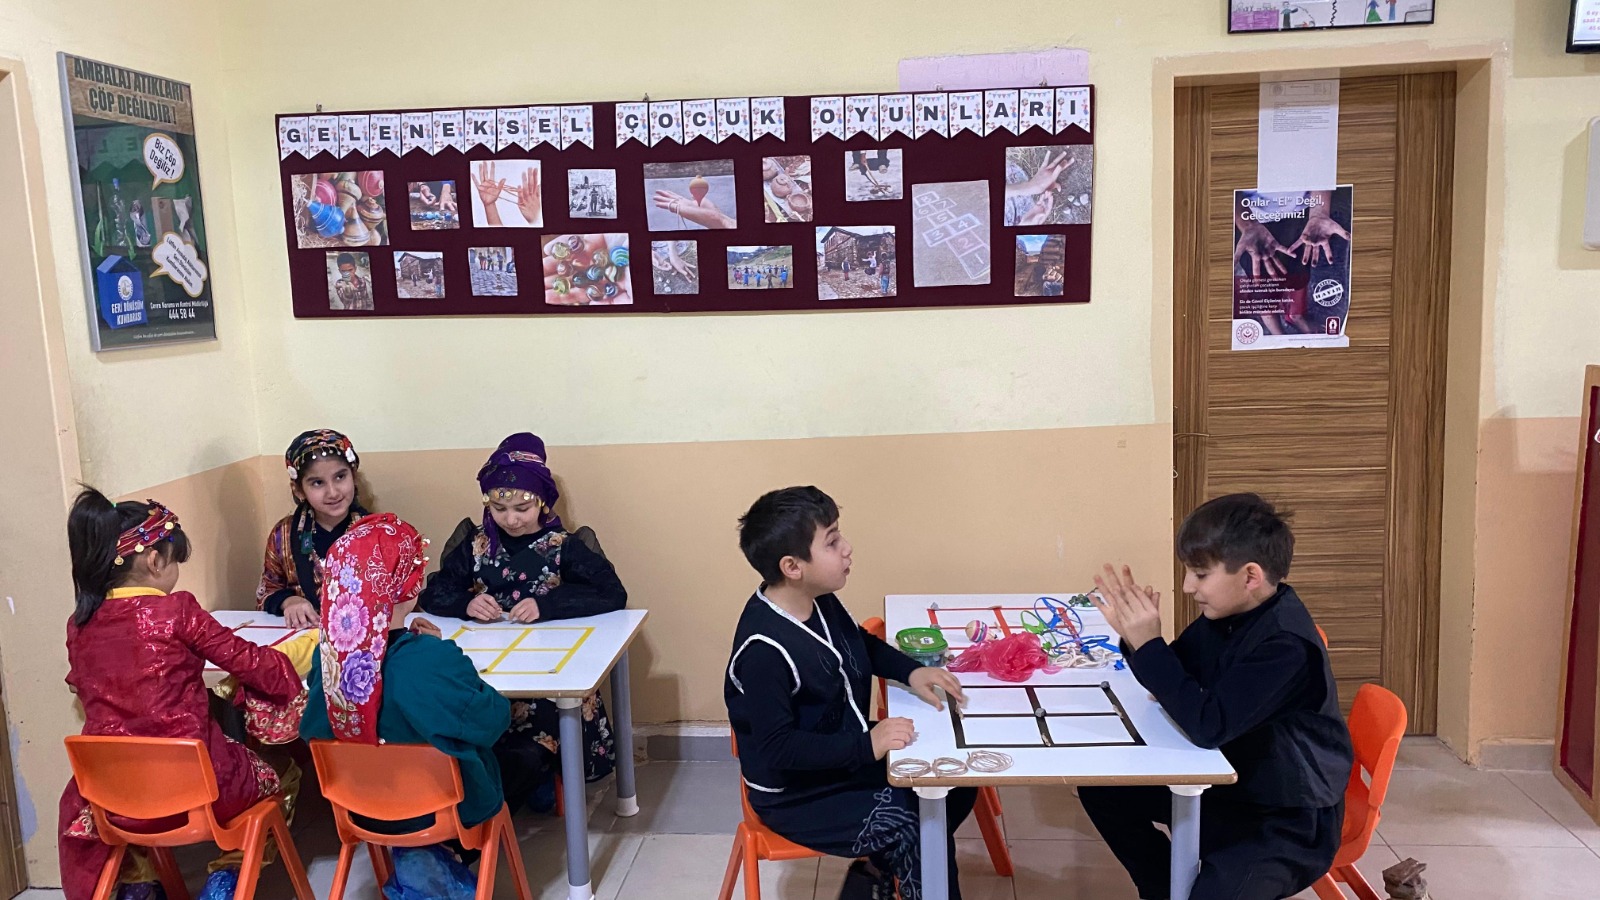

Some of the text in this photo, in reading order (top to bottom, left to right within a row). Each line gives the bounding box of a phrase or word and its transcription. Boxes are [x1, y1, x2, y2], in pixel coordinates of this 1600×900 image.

[74, 57, 185, 102] AMBALAJ ATIKLARI
[88, 87, 115, 113] ÇÖP
[286, 99, 1077, 143] GELENEKSEL ÇOCUK OYUNLARI
[154, 138, 177, 168] Biz Çöp
[1240, 197, 1270, 208] Onlar
[1295, 195, 1325, 208] Değil,
[936, 212, 948, 223] 5
[1240, 208, 1306, 222] Geleceğimiz!
[958, 220, 968, 228] 4
[931, 229, 945, 241] 3
[957, 237, 975, 250] 2
[975, 253, 984, 264] 1
[1315, 286, 1342, 299] HAYIR
[168, 309, 180, 320] 444
[188, 307, 196, 319] 44
